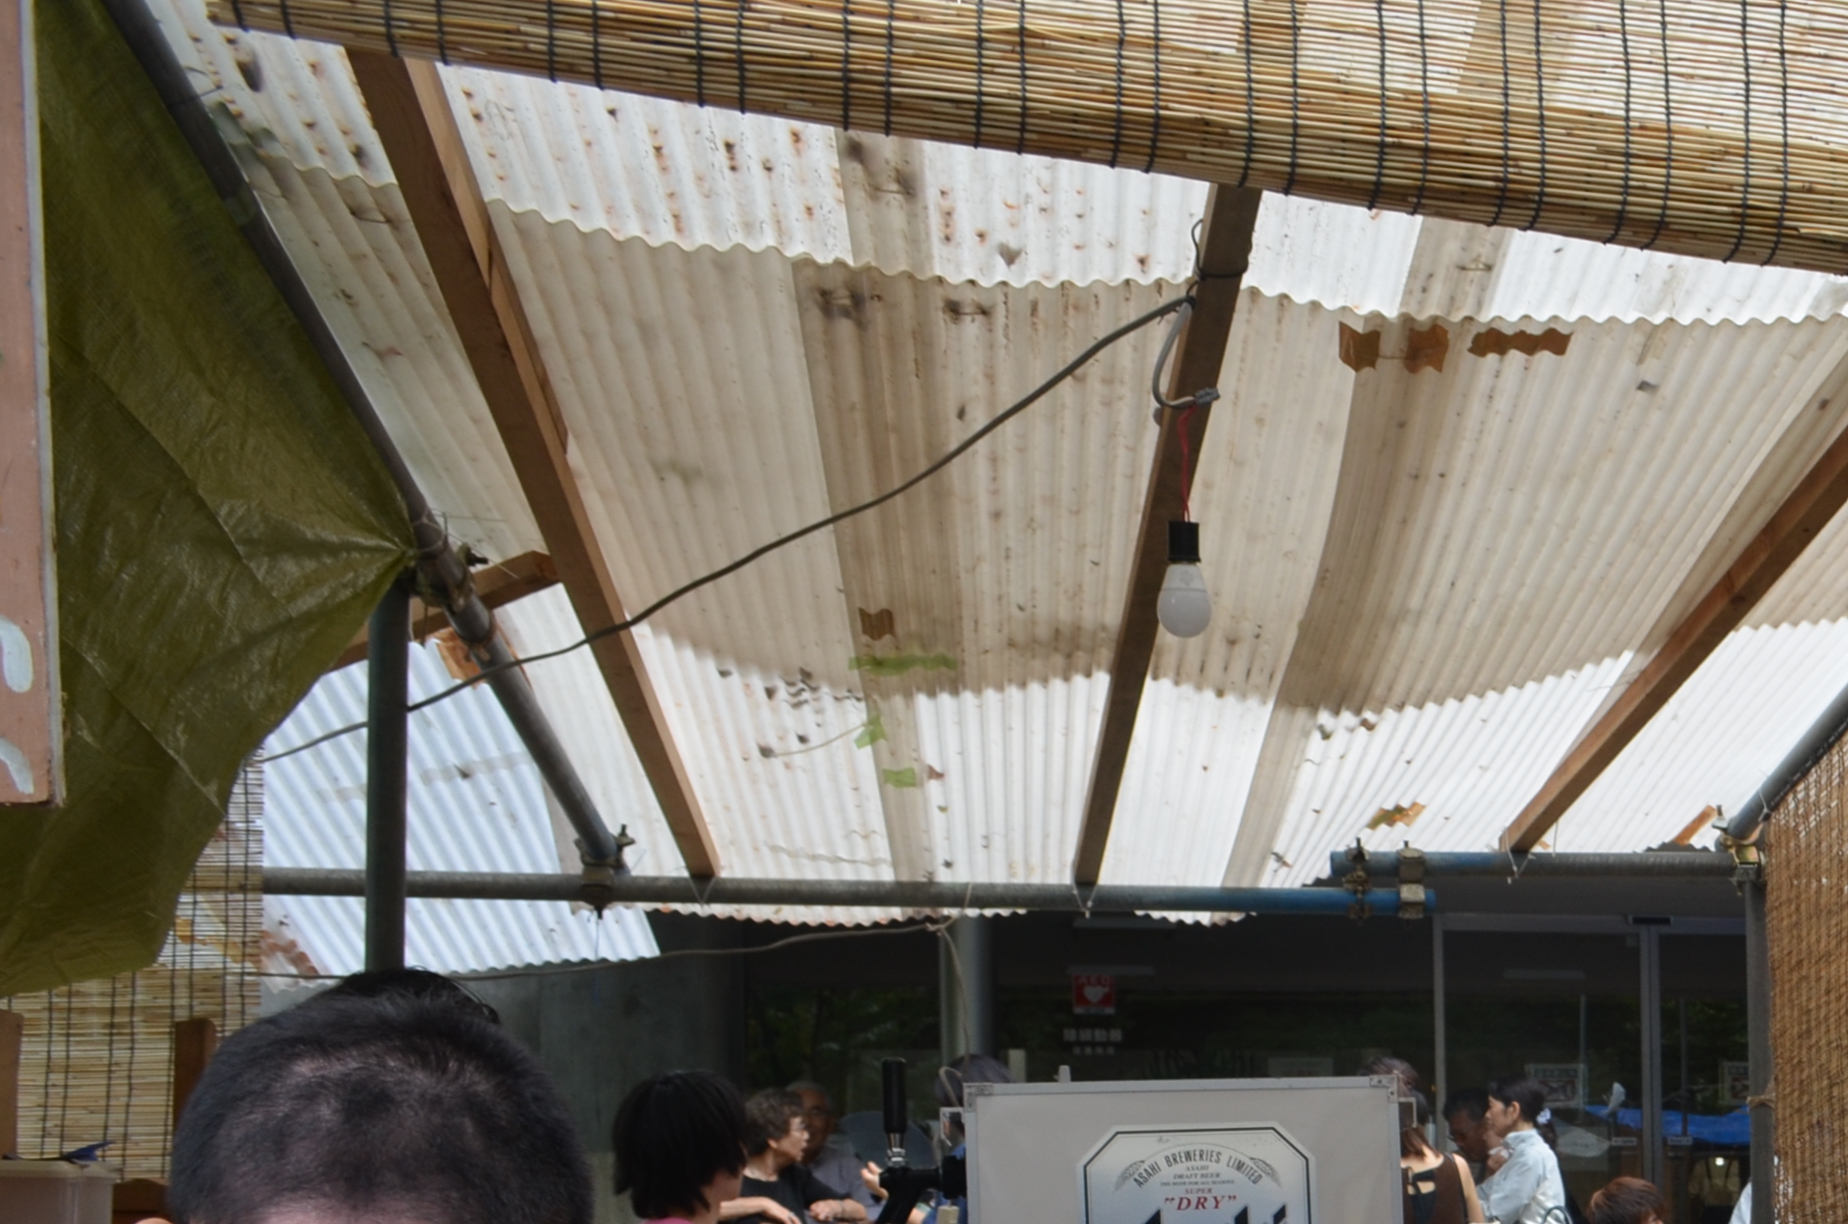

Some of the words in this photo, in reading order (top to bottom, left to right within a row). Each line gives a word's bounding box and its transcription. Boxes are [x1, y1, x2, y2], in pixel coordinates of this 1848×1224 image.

[1133, 1161, 1162, 1188] ASAHI
[1164, 1149, 1222, 1168] BREWERIES
[1226, 1155, 1263, 1185] LIMITED
